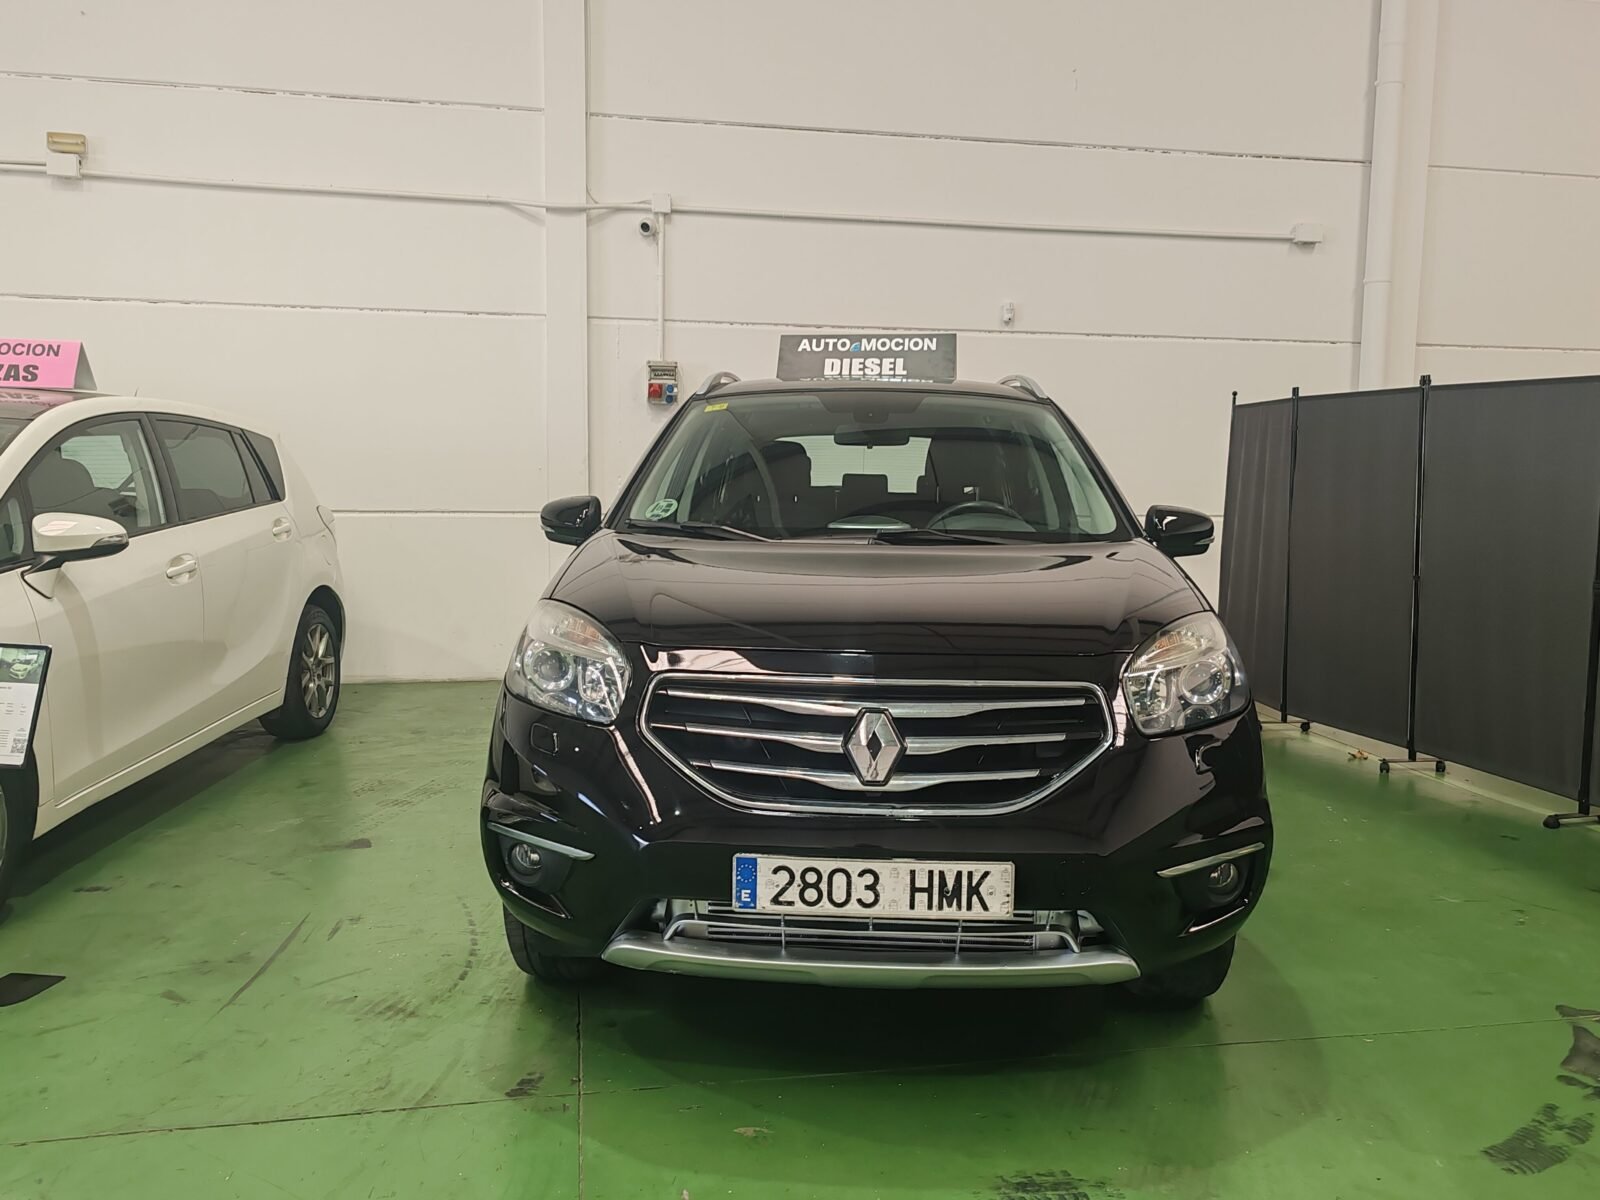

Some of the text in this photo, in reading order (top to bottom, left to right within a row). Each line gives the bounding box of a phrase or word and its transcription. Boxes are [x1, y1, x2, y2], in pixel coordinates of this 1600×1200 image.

[0, 363, 40, 382] AS
[823, 357, 908, 376] DIESEL
[741, 889, 751, 901] E
[769, 864, 992, 913] 2803 HMK
